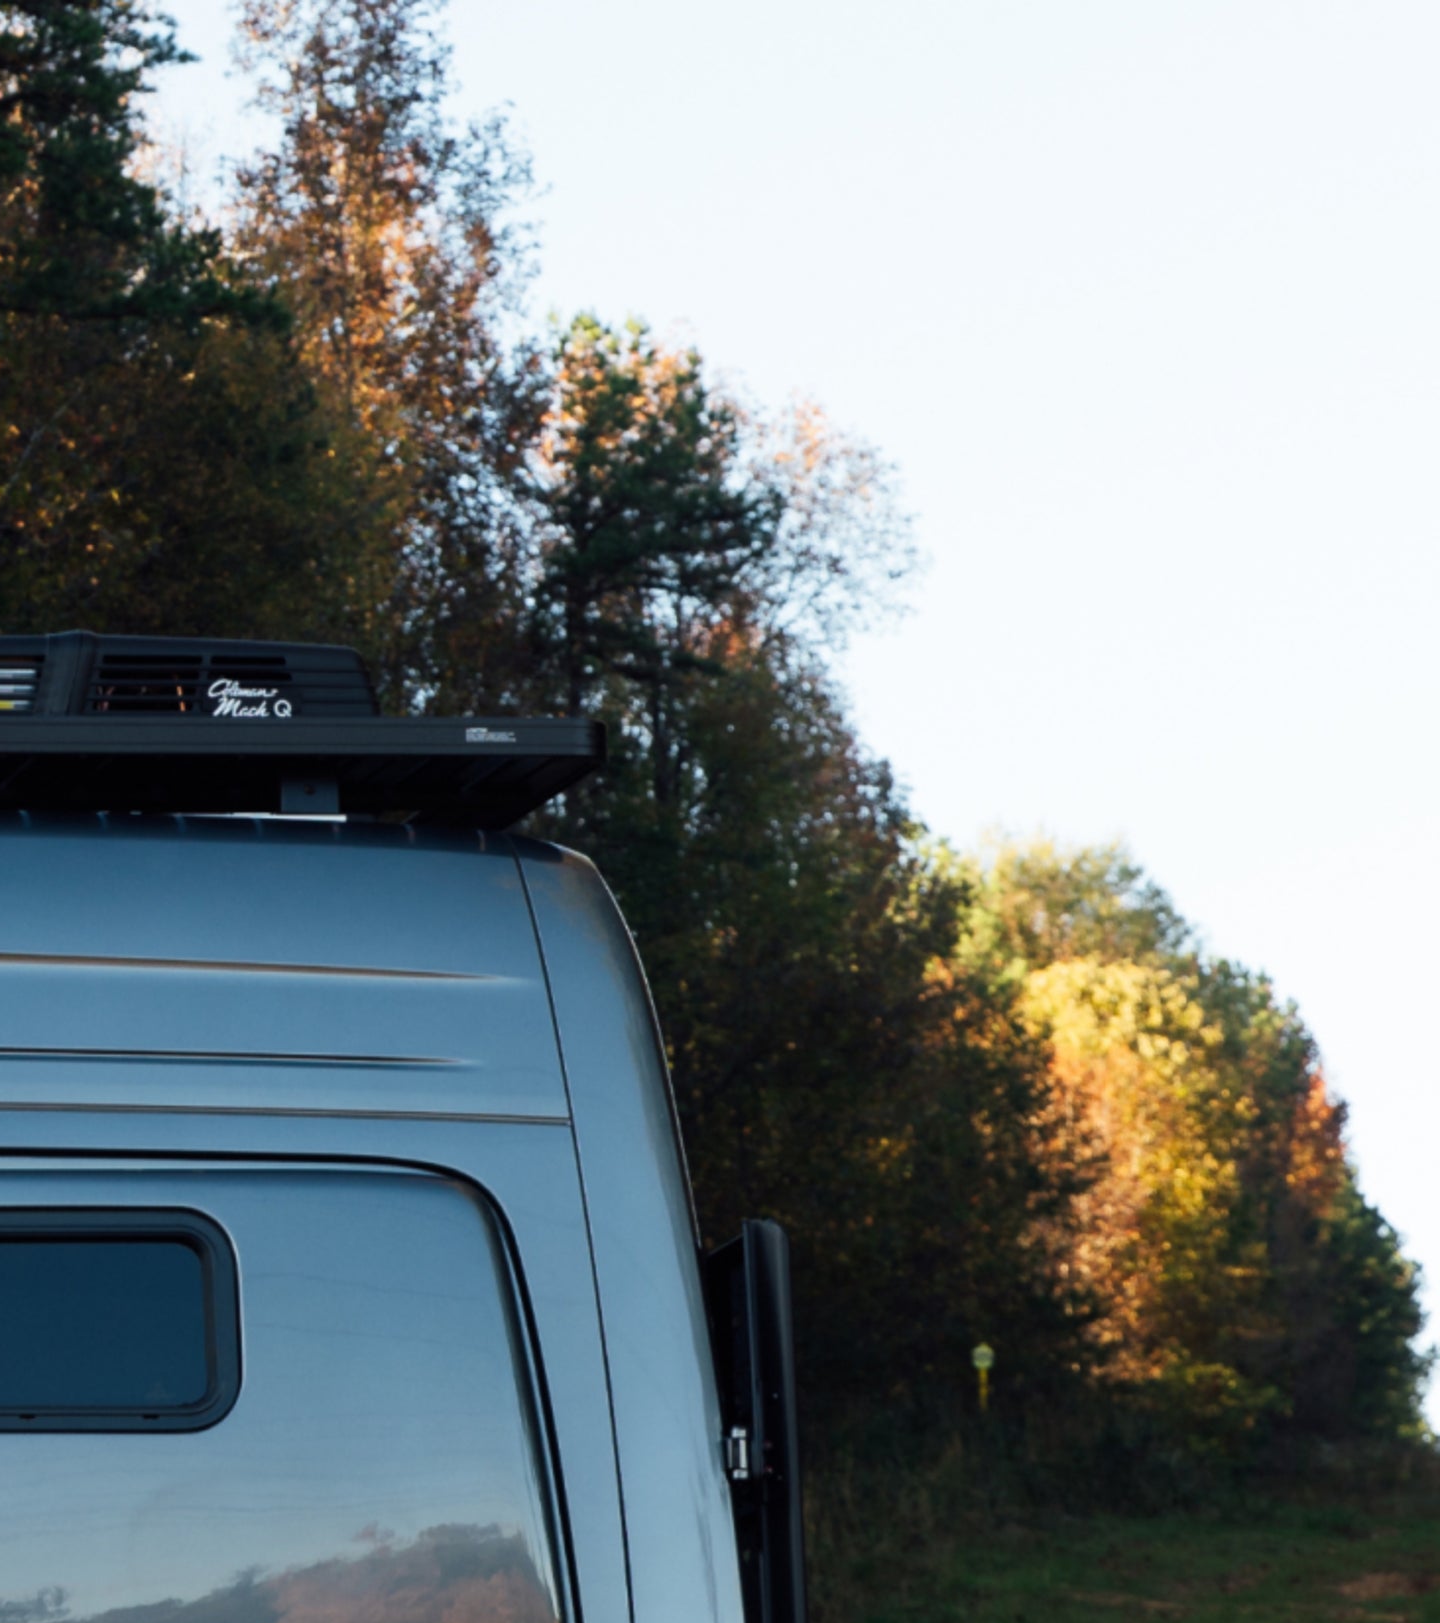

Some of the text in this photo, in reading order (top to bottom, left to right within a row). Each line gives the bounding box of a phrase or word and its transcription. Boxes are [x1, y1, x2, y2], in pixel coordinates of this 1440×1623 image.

[208, 678, 278, 697] Coleman
[213, 696, 292, 717] Mach Q
